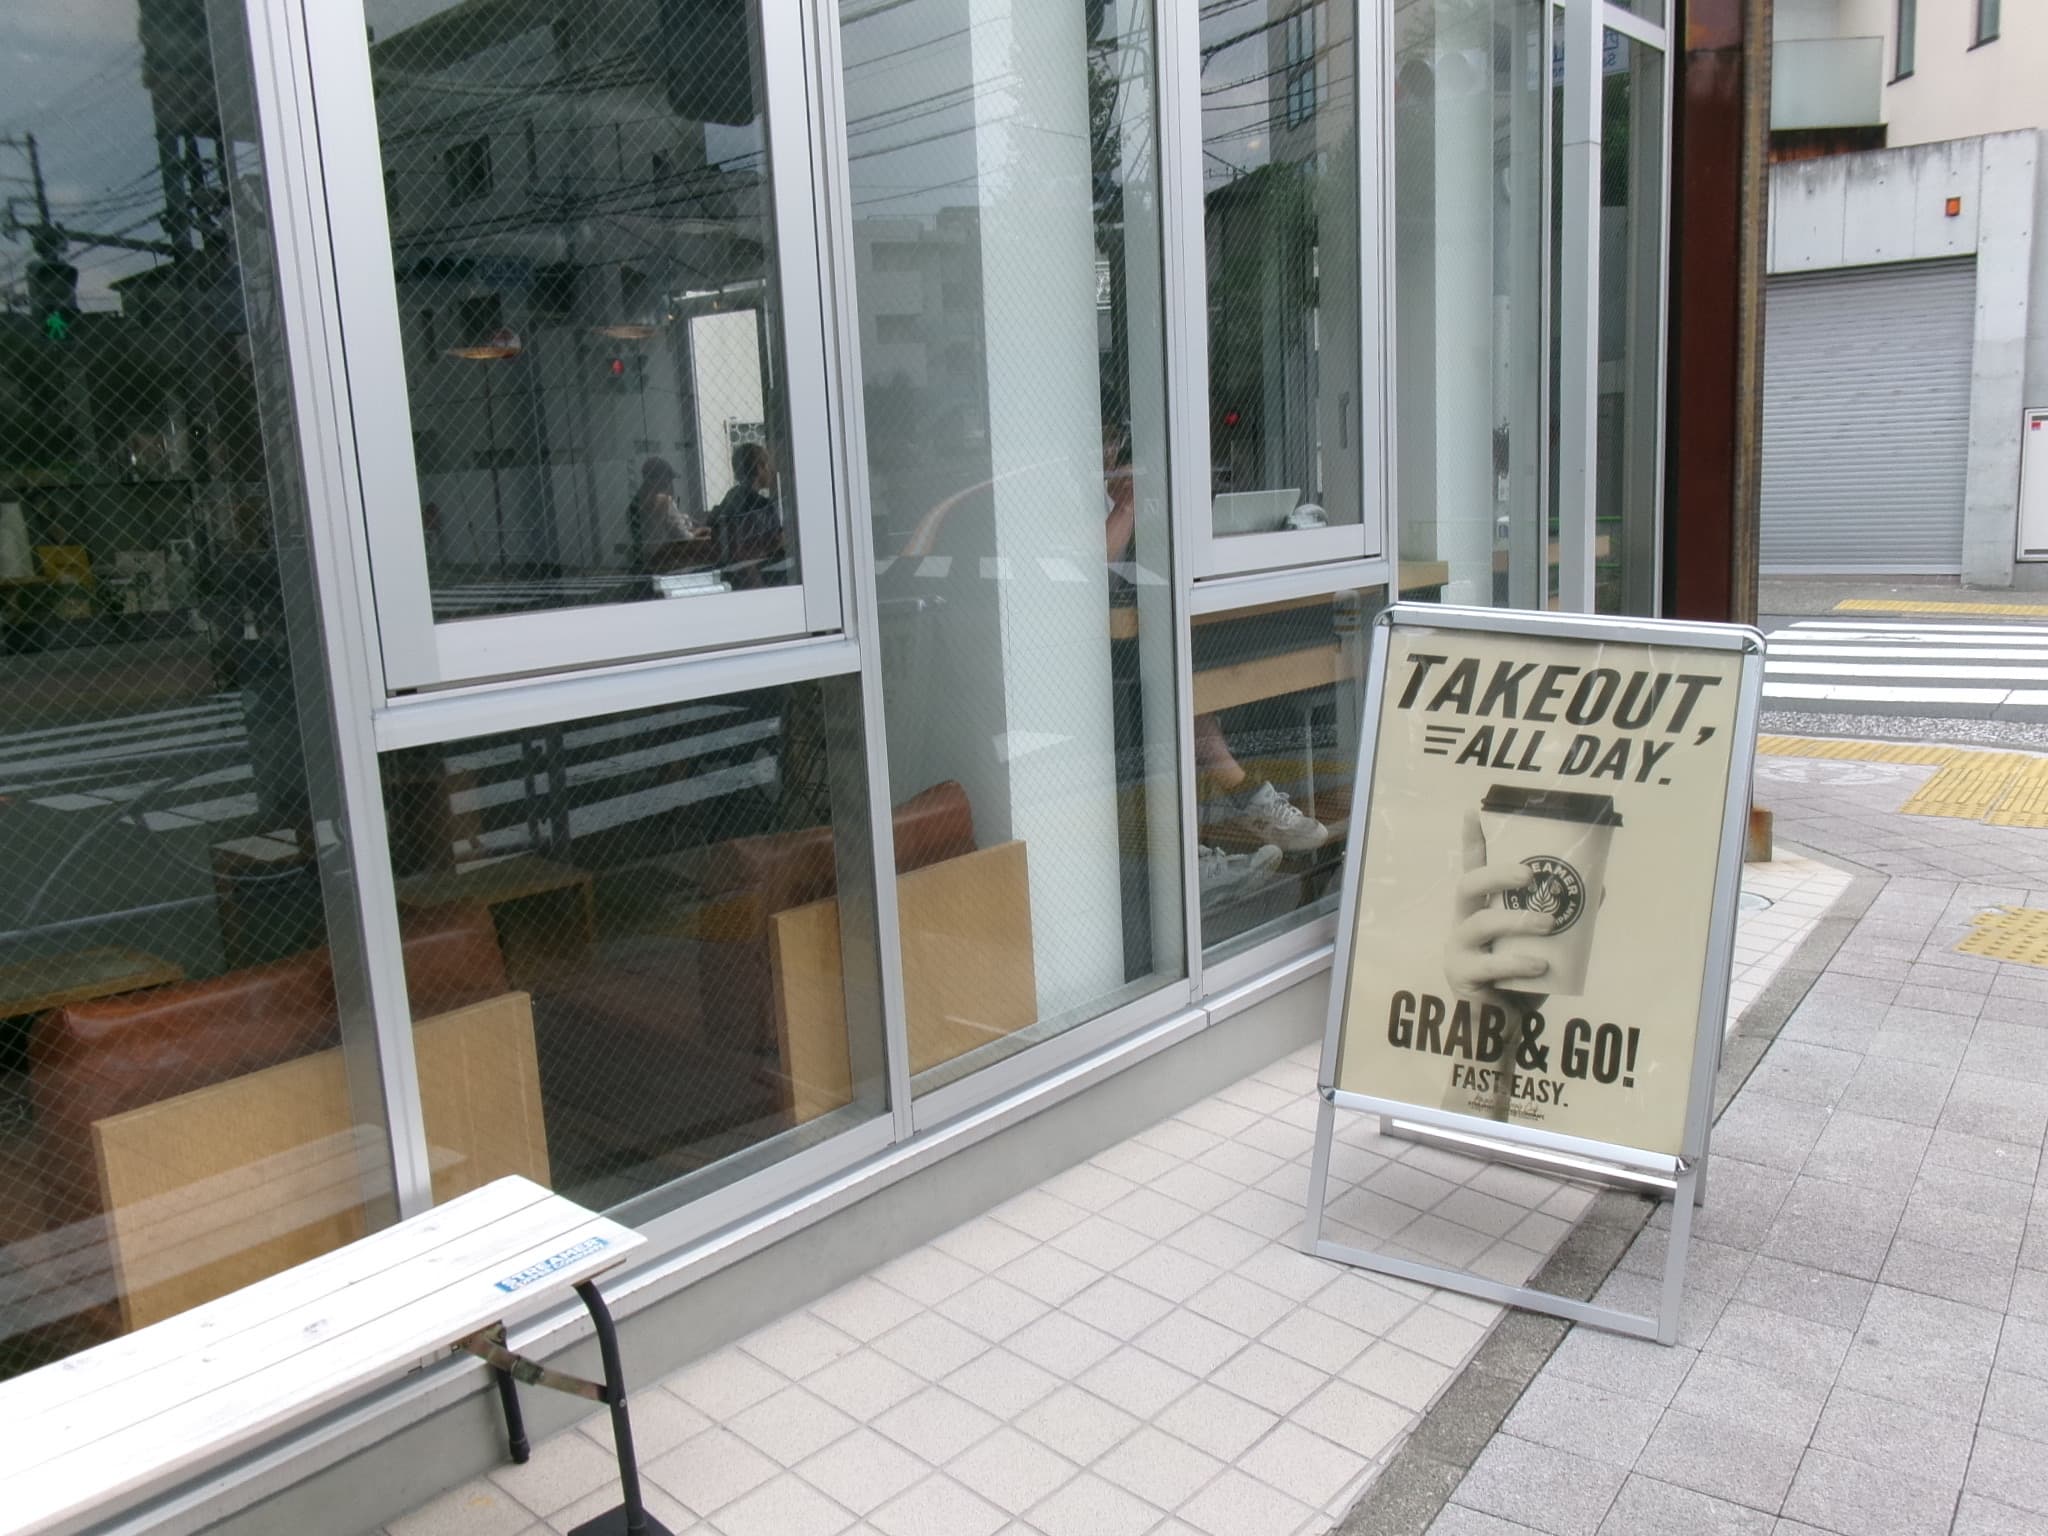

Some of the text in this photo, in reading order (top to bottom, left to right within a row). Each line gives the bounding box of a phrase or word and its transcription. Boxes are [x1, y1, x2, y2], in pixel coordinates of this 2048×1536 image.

[1397, 653, 1722, 746] TAKEOUT,
[1455, 725, 1674, 785] ALL DAY.
[1531, 862, 1578, 896] EAMER
[1387, 990, 1641, 1088] GRAB & GO!
[1511, 1074, 1569, 1107] EASY.
